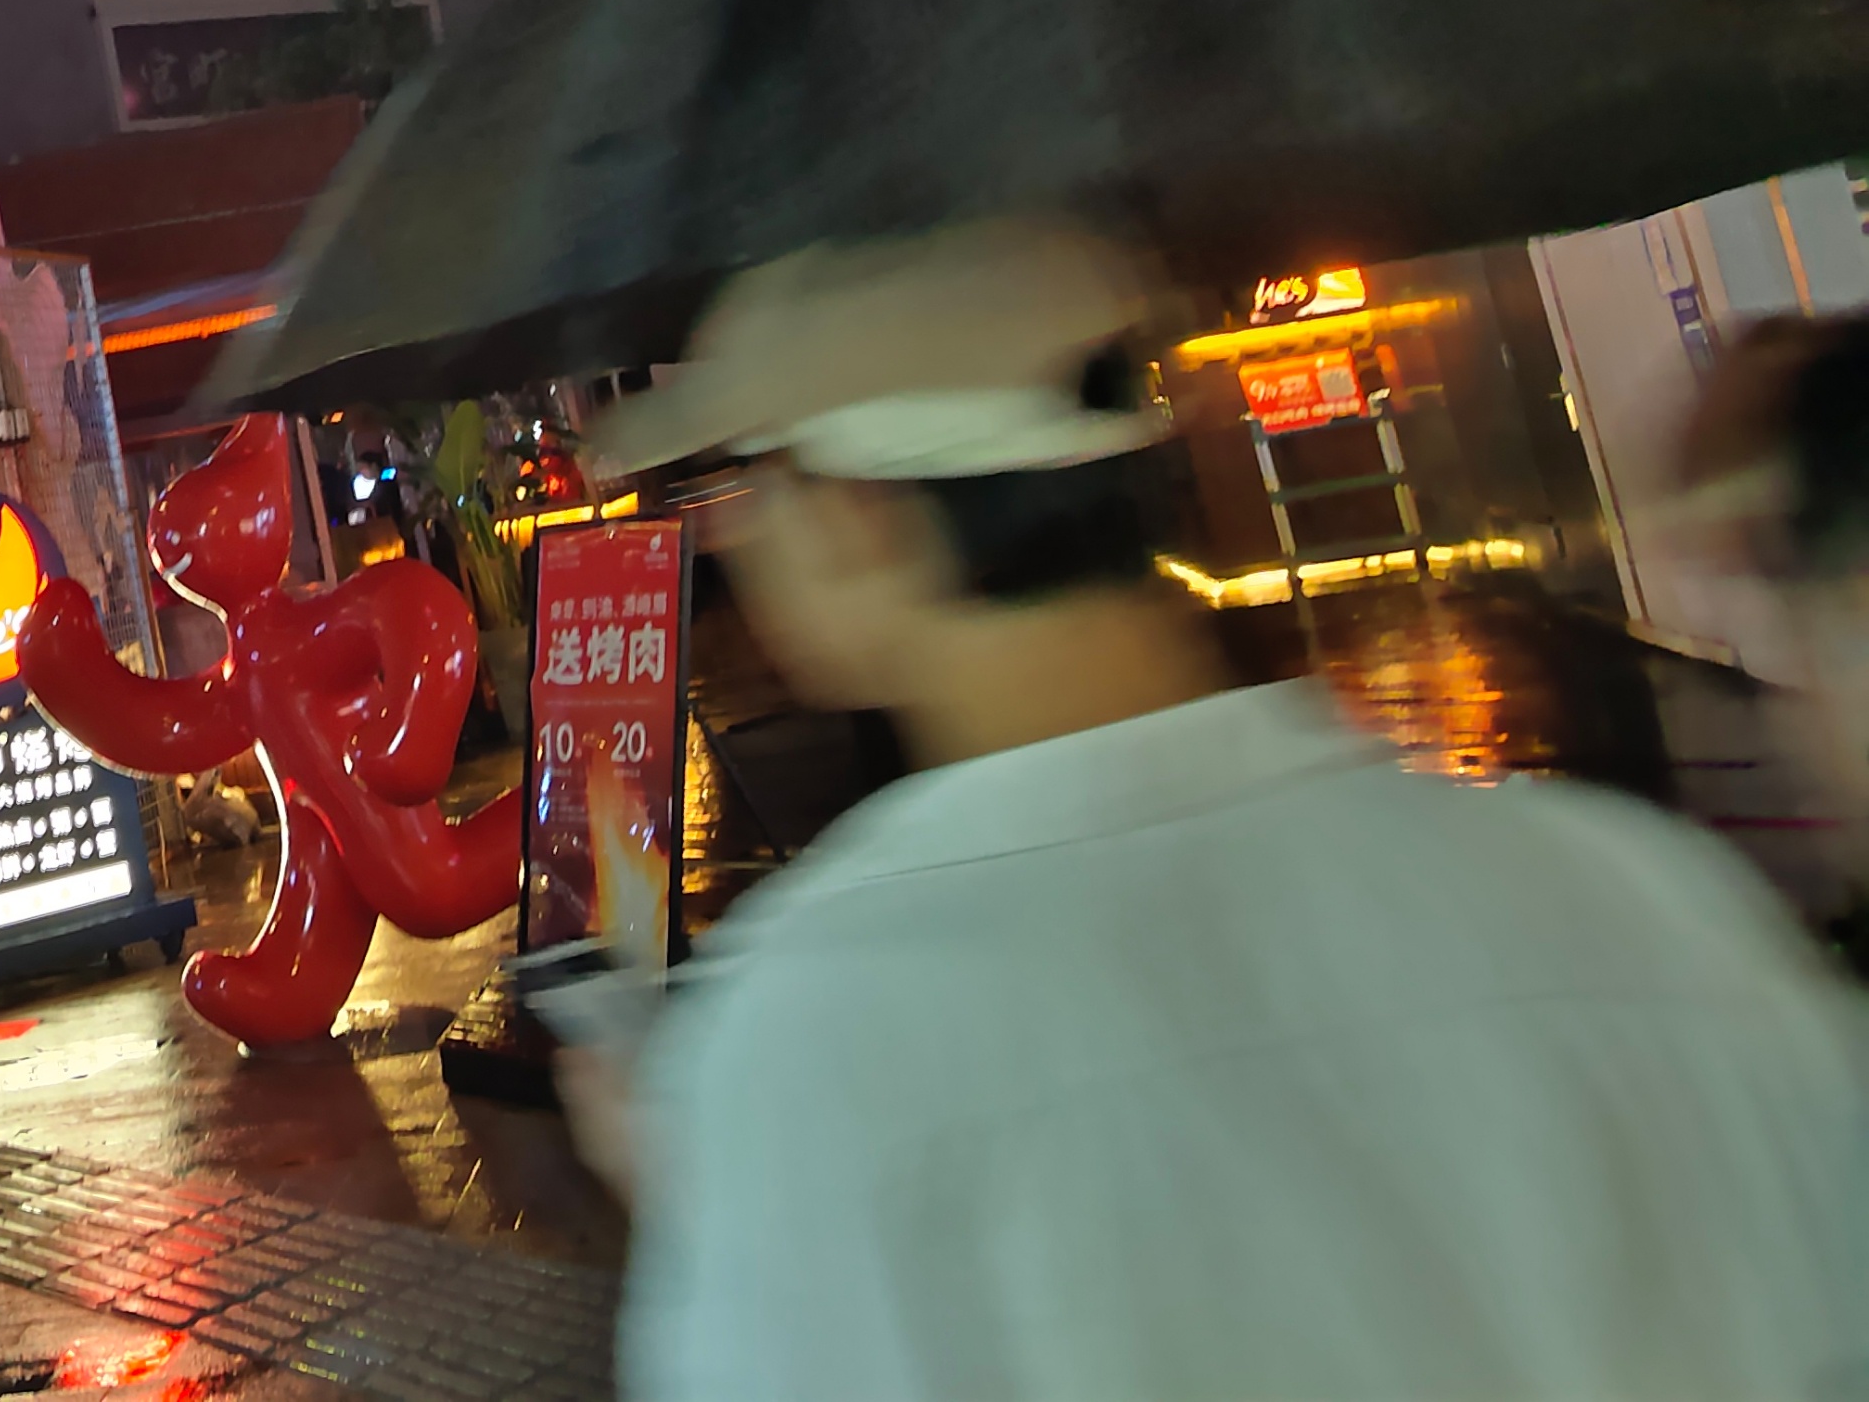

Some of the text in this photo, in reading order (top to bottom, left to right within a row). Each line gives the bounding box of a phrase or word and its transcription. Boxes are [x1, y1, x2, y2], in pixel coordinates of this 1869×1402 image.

[542, 621, 667, 685] 送烤肉
[538, 720, 647, 764] 10 20
